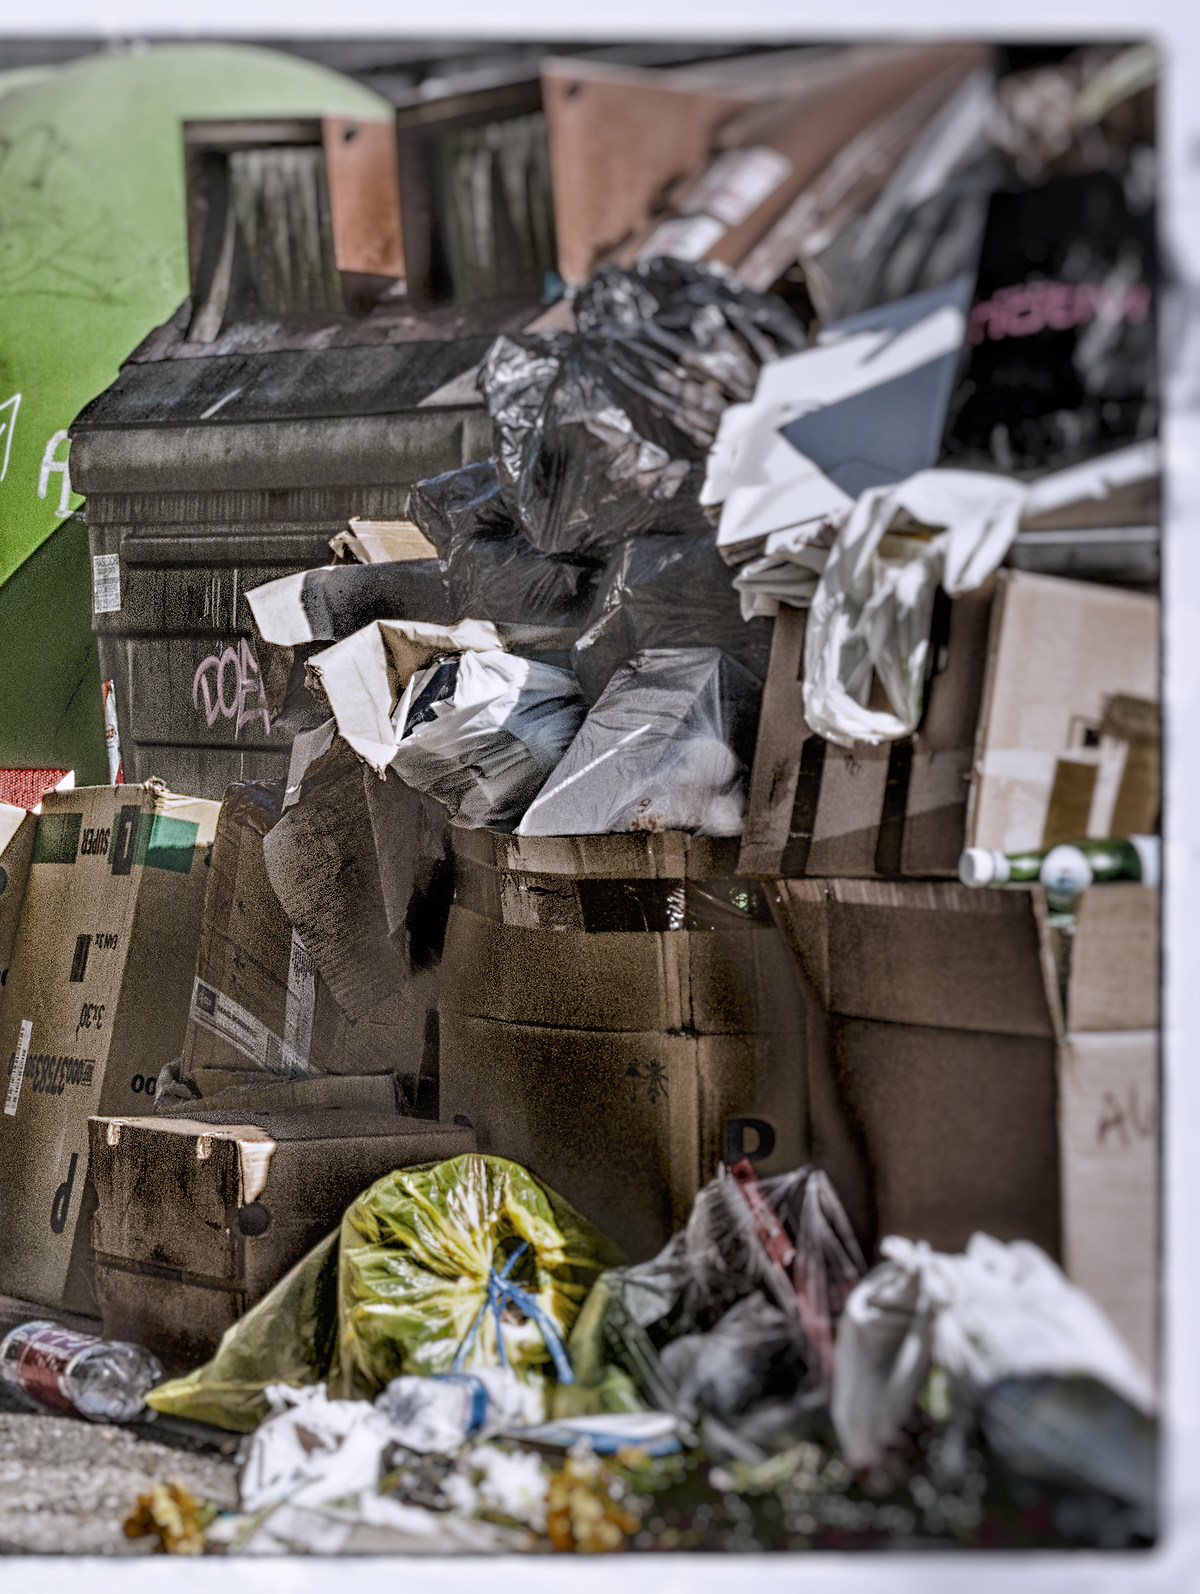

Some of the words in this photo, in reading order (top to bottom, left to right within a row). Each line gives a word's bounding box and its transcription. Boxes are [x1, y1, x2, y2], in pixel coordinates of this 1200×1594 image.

[81, 828, 111, 855] SUPER
[80, 1003, 105, 1029] 3x30
[51, 1152, 78, 1234] P
